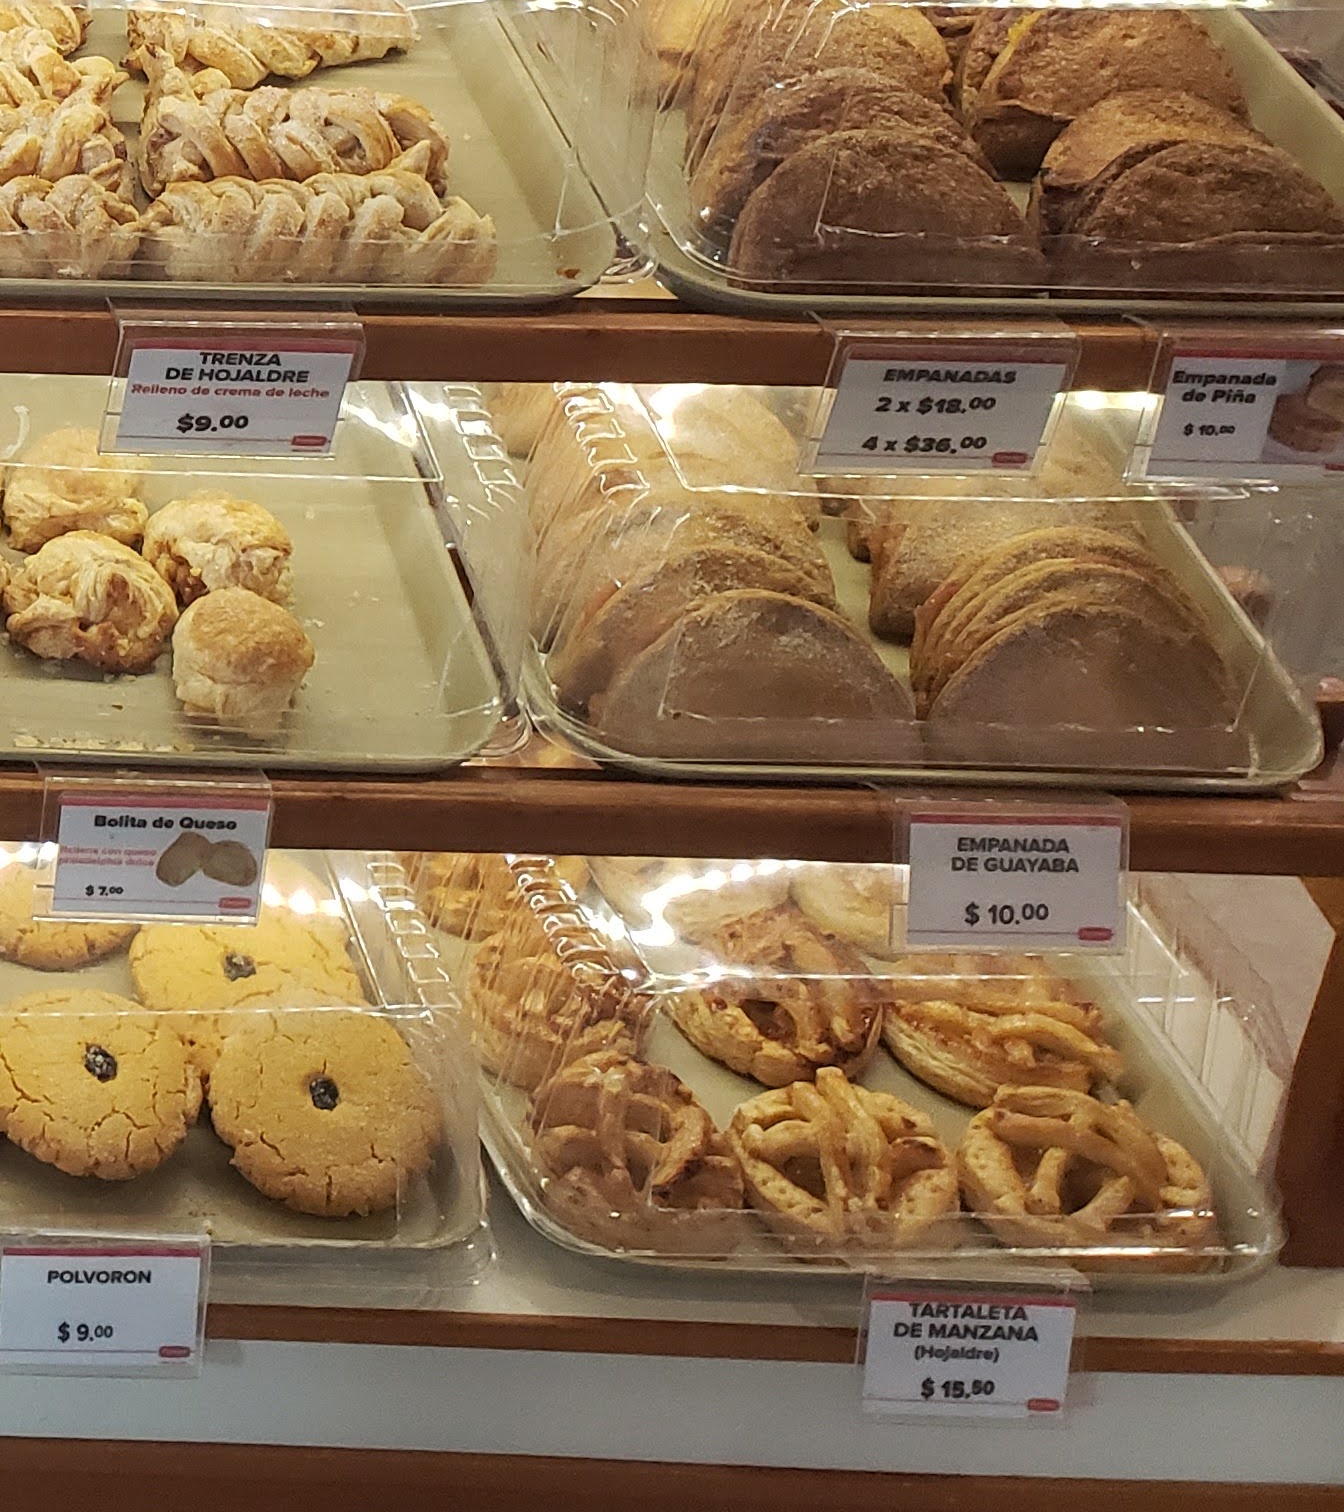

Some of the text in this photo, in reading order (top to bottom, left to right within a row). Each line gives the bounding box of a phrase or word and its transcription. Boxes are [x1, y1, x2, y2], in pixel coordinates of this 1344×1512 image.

[199, 352, 282, 366] TRENZA
[165, 368, 310, 383] DE HOJALDRE
[883, 368, 1017, 384] EMPANADAS
[1172, 370, 1278, 387] Empanada
[1182, 389, 1257, 404] de Piña
[875, 396, 997, 415] 2 x $18.00
[176, 413, 249, 433] $9.00
[1183, 423, 1194, 437] $
[862, 436, 988, 454] 4 x $36.00
[94, 815, 237, 830] Bolita de Queso
[957, 837, 1070, 853] EMPANADA
[951, 857, 1079, 873] DE GUAYABA
[964, 902, 1049, 926] $ 10.00
[47, 1270, 152, 1284] POLVORON
[909, 1302, 1028, 1321] TARTALETA
[57, 1321, 113, 1343] $ 9.00
[893, 1322, 1038, 1341] DE MANZANA
[914, 1344, 1000, 1363] (Hojaldre)
[921, 1377, 995, 1400] $ 15.50
